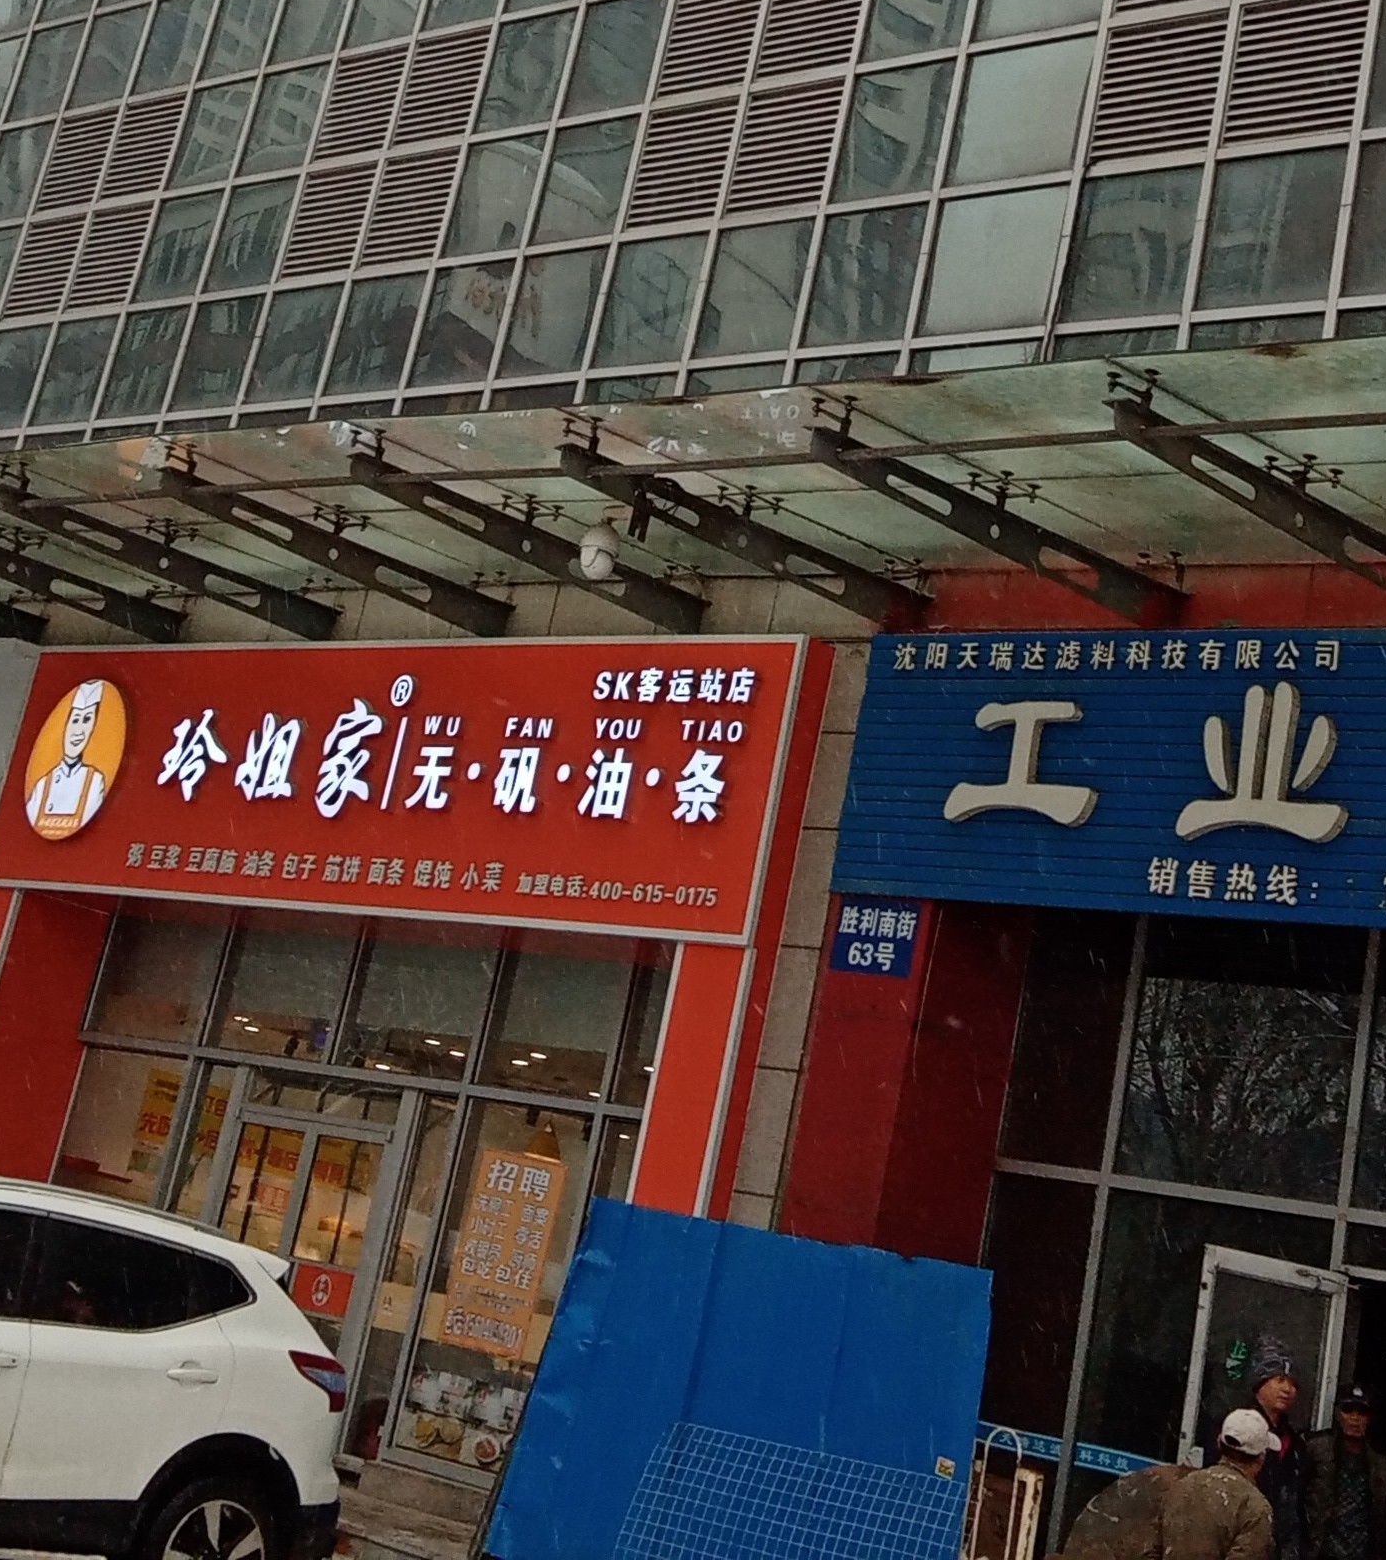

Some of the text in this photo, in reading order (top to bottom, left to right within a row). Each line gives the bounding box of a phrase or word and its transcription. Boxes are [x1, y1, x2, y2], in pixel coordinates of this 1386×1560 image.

[894, 639, 1342, 672] 沈阳天瑞达滤料科技有限公司
[593, 667, 755, 703] SK客运站店
[424, 716, 744, 742] WU FAN YOU TIAO
[147, 844, 182, 870] 豆浆
[241, 850, 276, 877] 油条
[282, 852, 317, 880] 包子
[367, 857, 405, 886] 面条
[413, 859, 453, 889] 馄饨
[460, 862, 504, 892] 小菜
[838, 906, 917, 940] 胜利南街
[848, 942, 895, 971] 63号
[487, 1159, 551, 1201] 招聘
